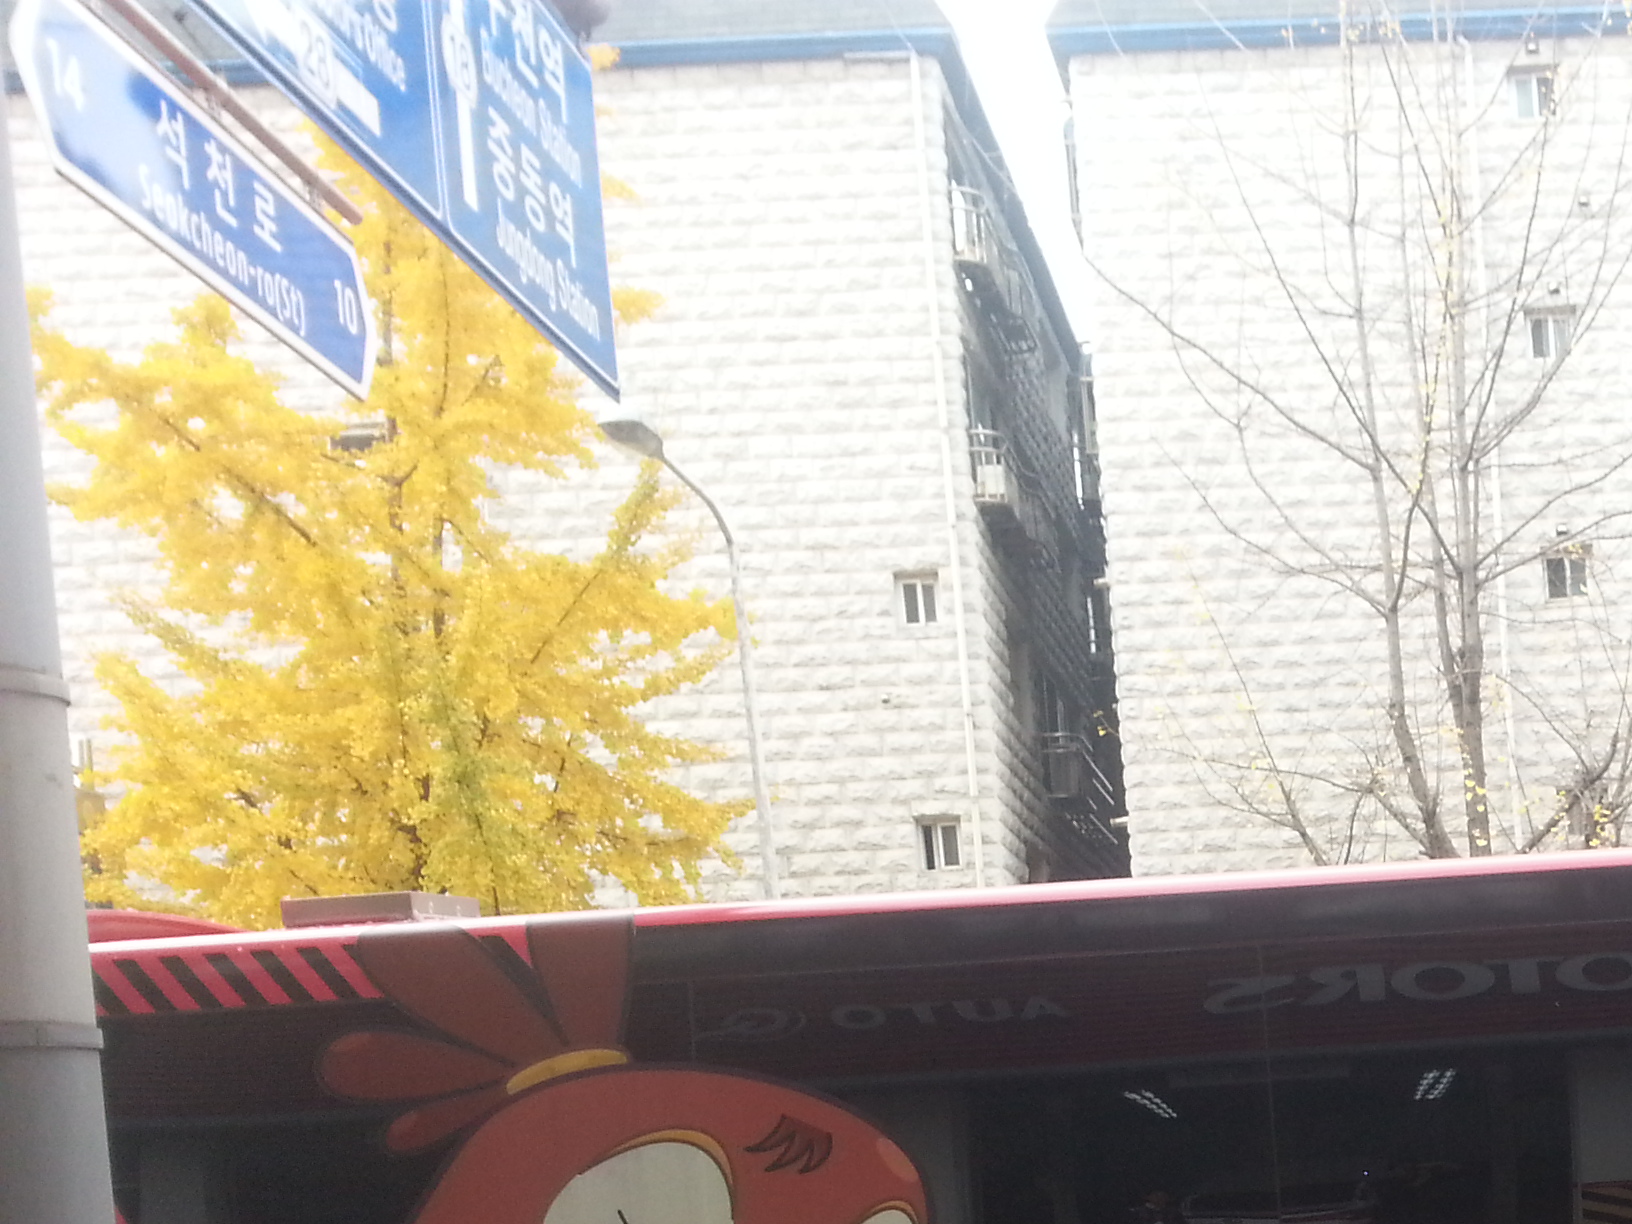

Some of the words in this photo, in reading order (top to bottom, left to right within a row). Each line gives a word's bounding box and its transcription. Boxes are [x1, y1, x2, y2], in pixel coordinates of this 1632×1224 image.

[46, 37, 84, 111] 14
[480, 25, 537, 137] Bucheon
[538, 98, 582, 189] Station
[489, 0, 568, 124] 천역
[156, 99, 282, 252] 석천로
[487, 105, 576, 269] 중동역
[334, 279, 358, 335] 10
[496, 195, 556, 313] Jungdong
[556, 258, 600, 341] Station
